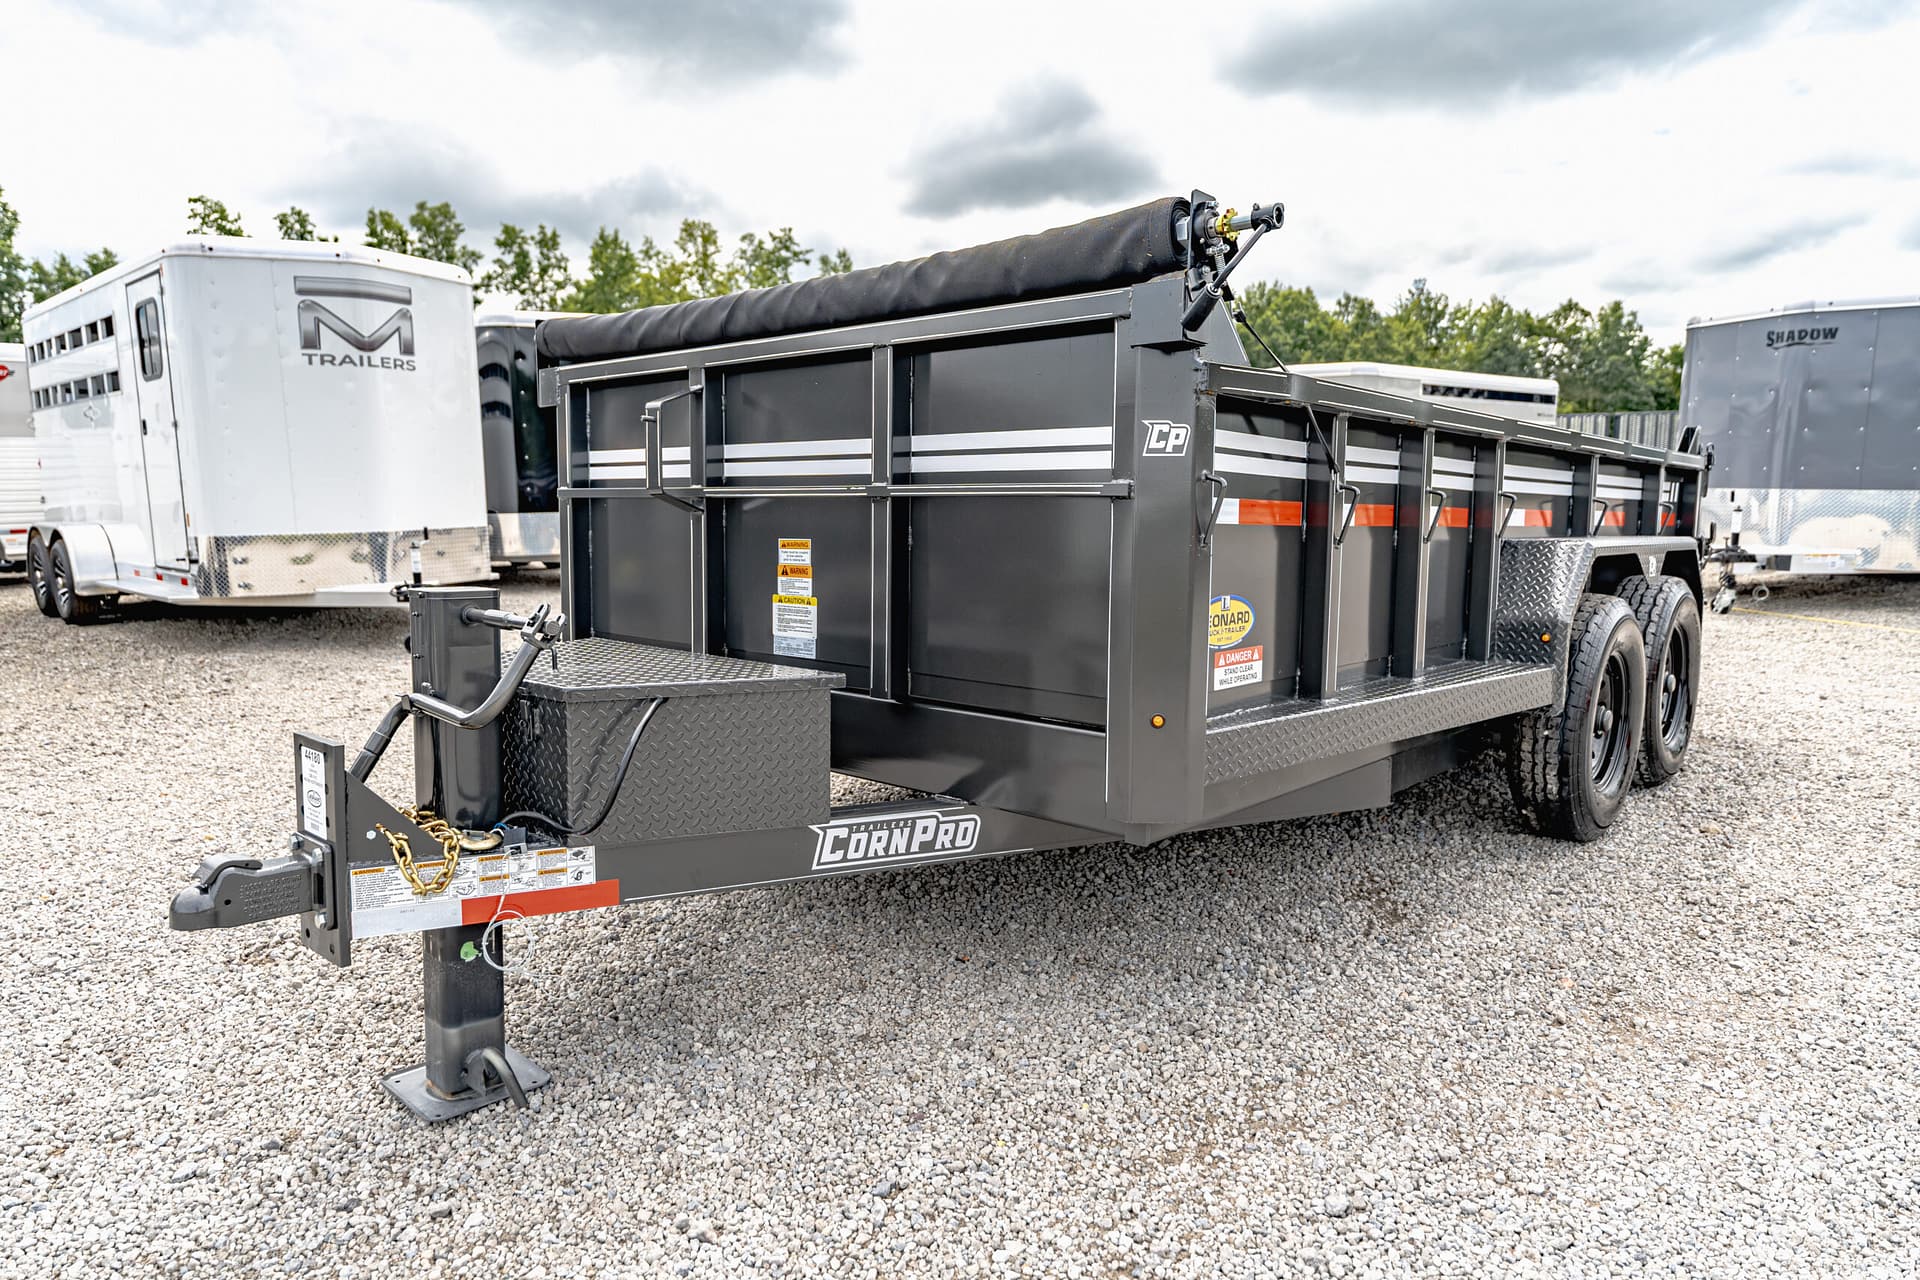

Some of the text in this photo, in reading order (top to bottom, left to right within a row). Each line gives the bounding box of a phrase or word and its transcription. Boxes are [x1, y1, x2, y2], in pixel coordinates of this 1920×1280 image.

[1766, 327, 1839, 347] SHADOW
[301, 353, 416, 371] TRAILERS
[1149, 424, 1187, 452] CP
[789, 567, 809, 576] WARNING
[783, 596, 806, 604] CAUTION
[1226, 650, 1252, 664] DANGER
[1224, 664, 1254, 676] STAND CLEAR
[1219, 672, 1258, 686] WHILE OPERATING
[852, 820, 912, 832] TRAILERS
